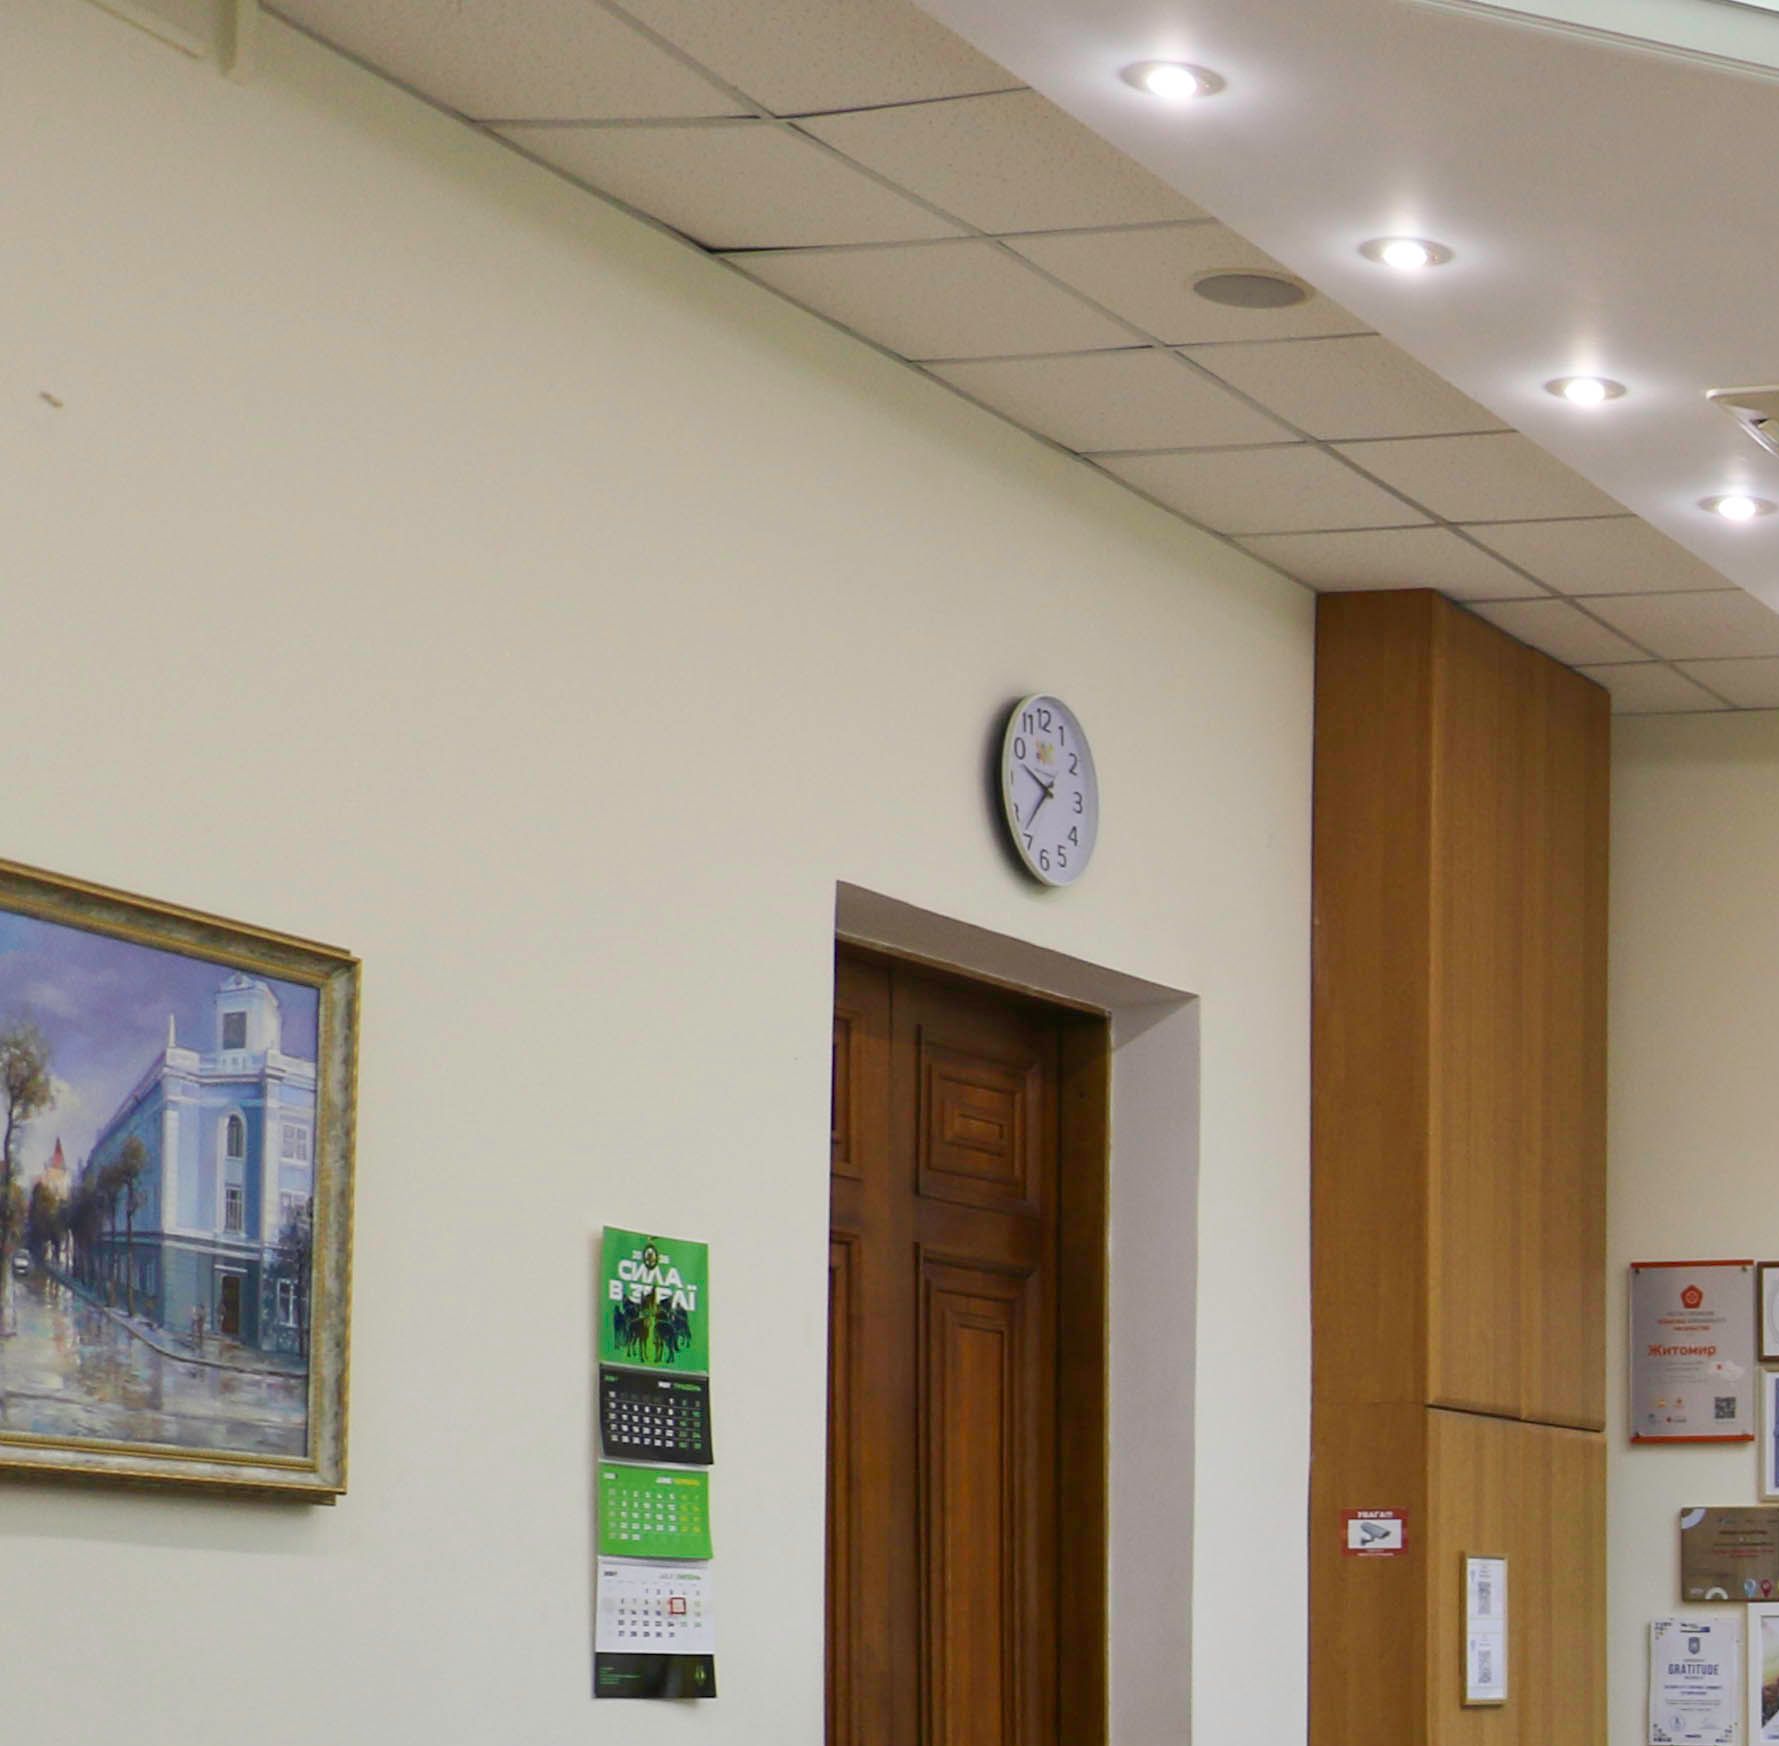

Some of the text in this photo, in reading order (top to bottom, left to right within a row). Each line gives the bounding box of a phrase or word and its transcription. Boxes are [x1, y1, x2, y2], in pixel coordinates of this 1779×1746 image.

[1022, 712, 1034, 735] 11
[1037, 708, 1052, 733] 12
[1058, 725, 1065, 746] 1
[1068, 752, 1079, 776] 2
[1072, 791, 1084, 815] 3
[1023, 832, 1033, 850] 7
[1068, 825, 1079, 847] 4
[1039, 849, 1050, 871] 6
[1057, 844, 1067, 868] 5
[618, 1259, 684, 1288] СИЛА
[608, 1279, 623, 1301] В
[1647, 1344, 1717, 1358] Житомир
[1668, 1663, 1719, 1675] GRATITUDE
